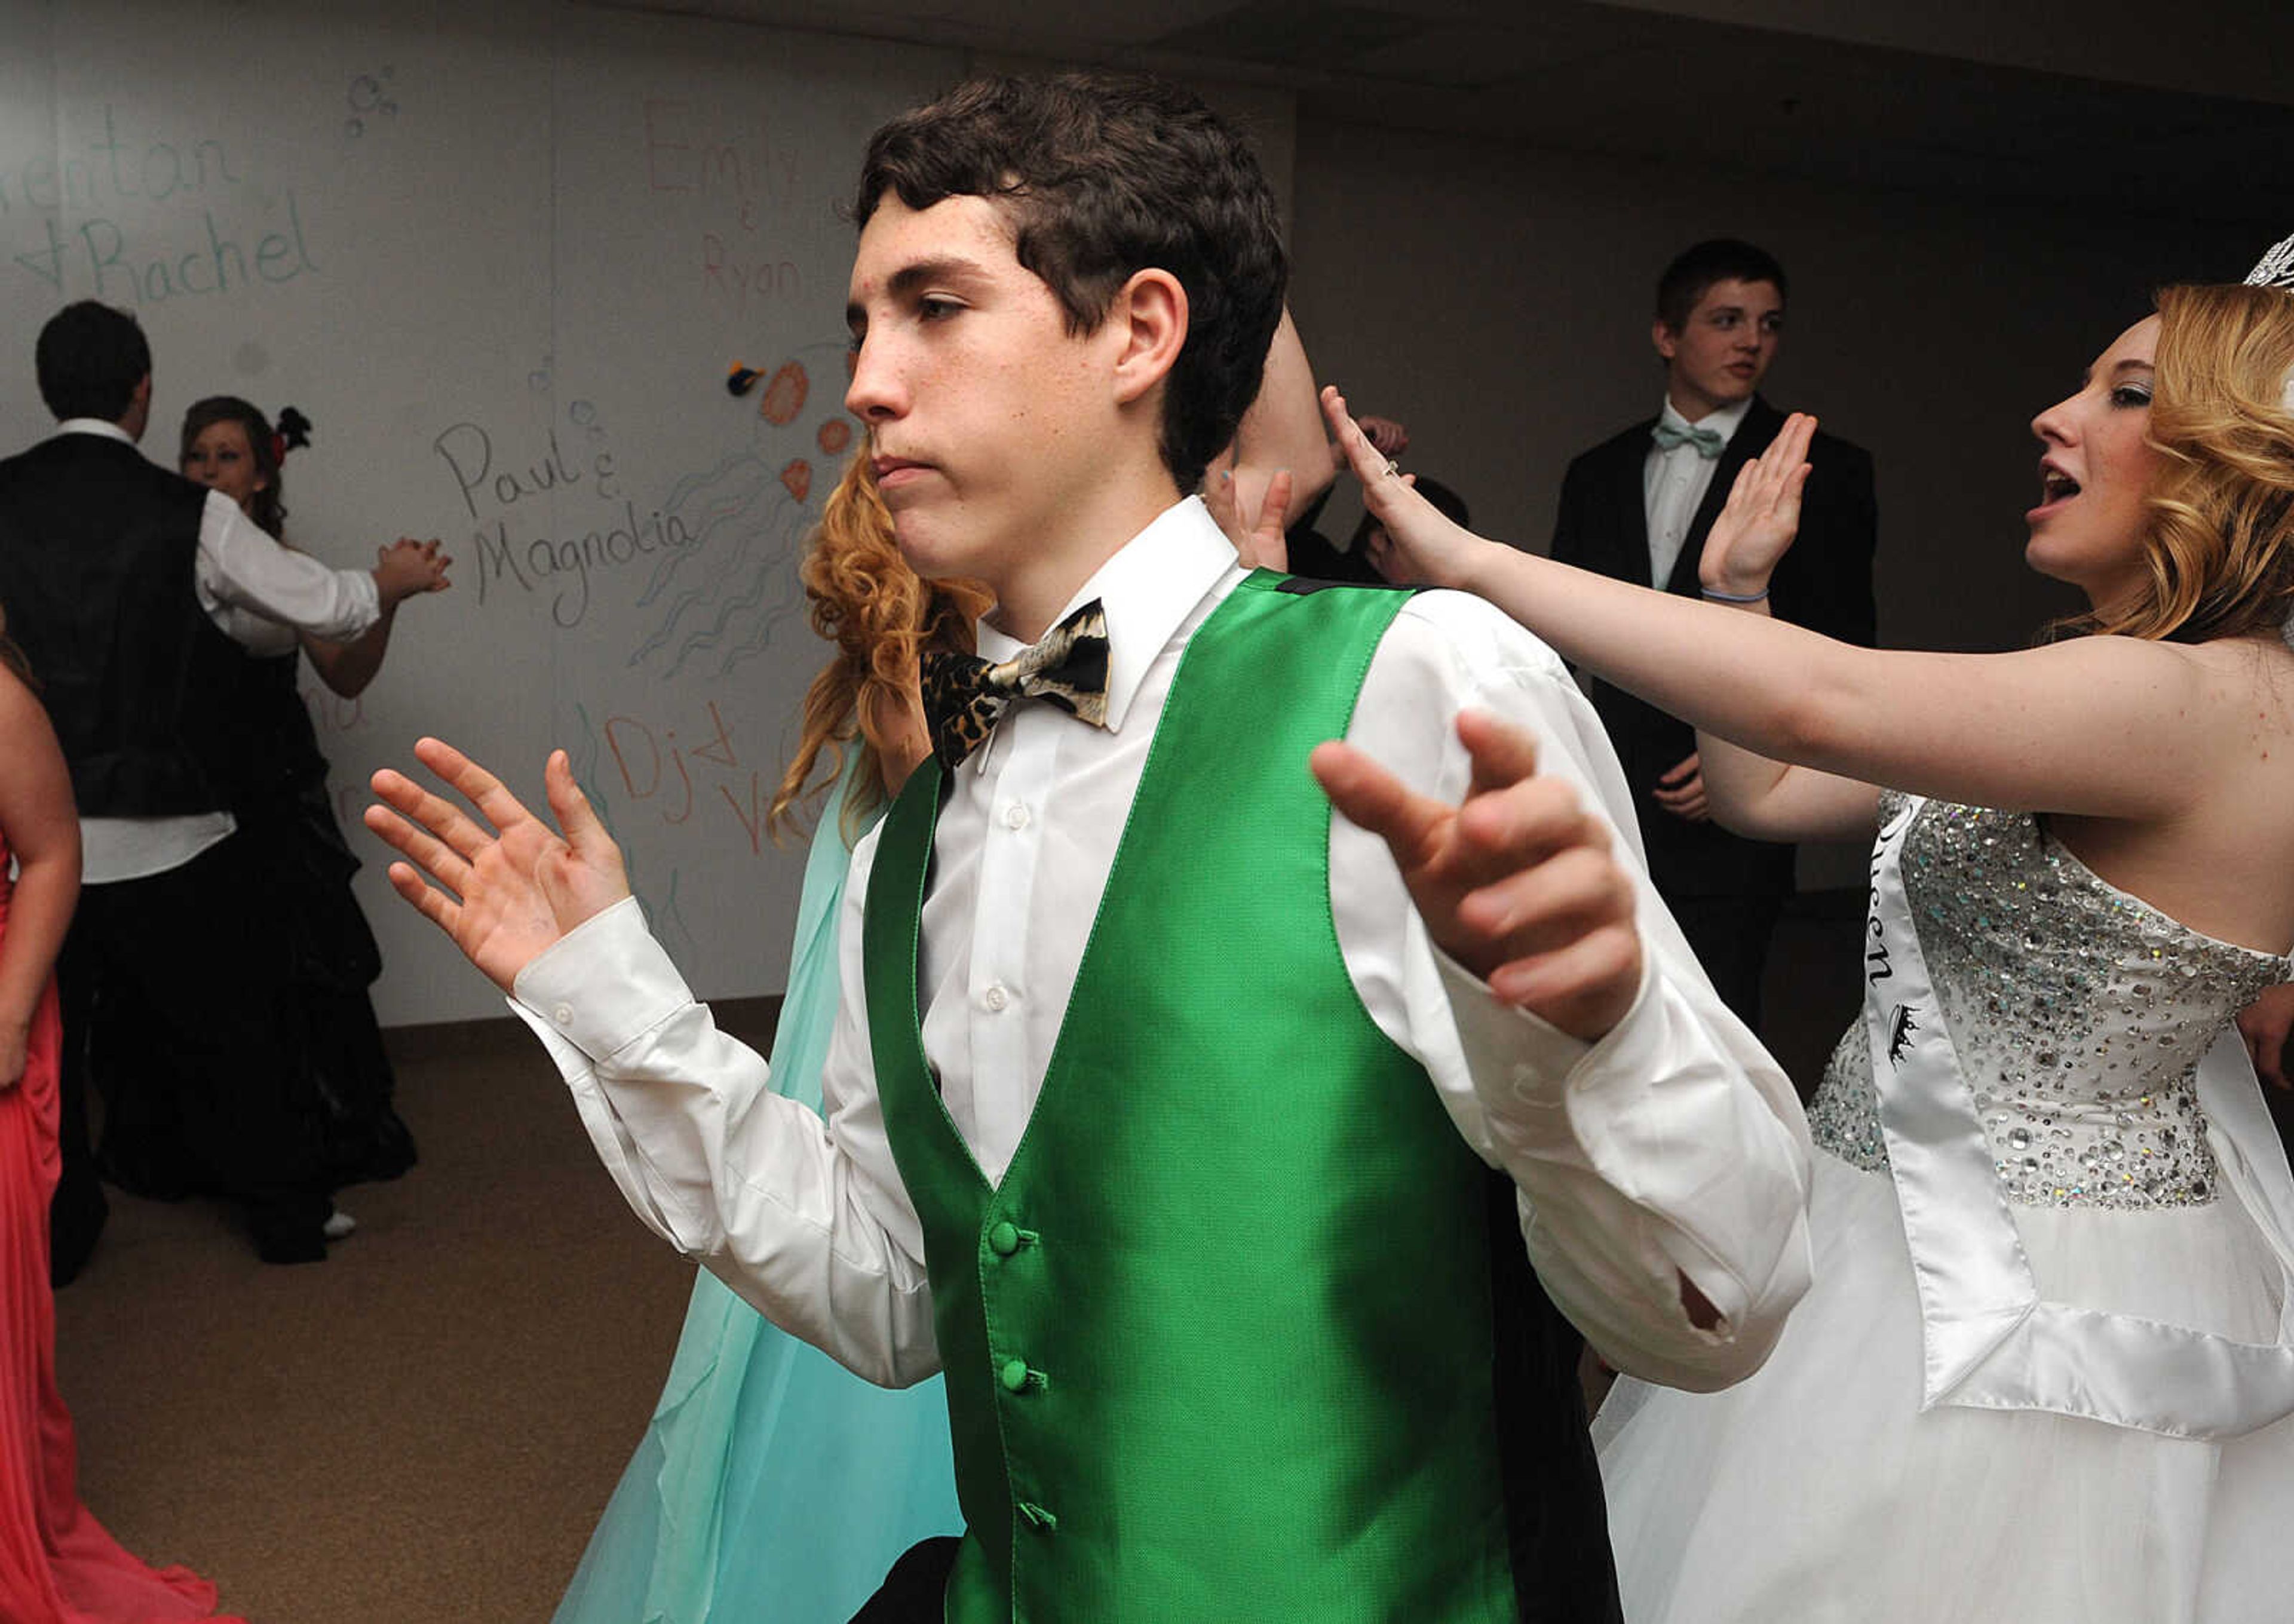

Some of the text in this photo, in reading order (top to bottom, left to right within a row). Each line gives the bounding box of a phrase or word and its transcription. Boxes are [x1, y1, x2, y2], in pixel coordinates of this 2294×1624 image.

[0, 103, 241, 212] enton
[80, 189, 319, 304] Rachel
[704, 231, 801, 319] Ryan
[433, 422, 581, 519] Paul
[473, 500, 698, 628] Magnolia
[604, 717, 692, 824] Dj
